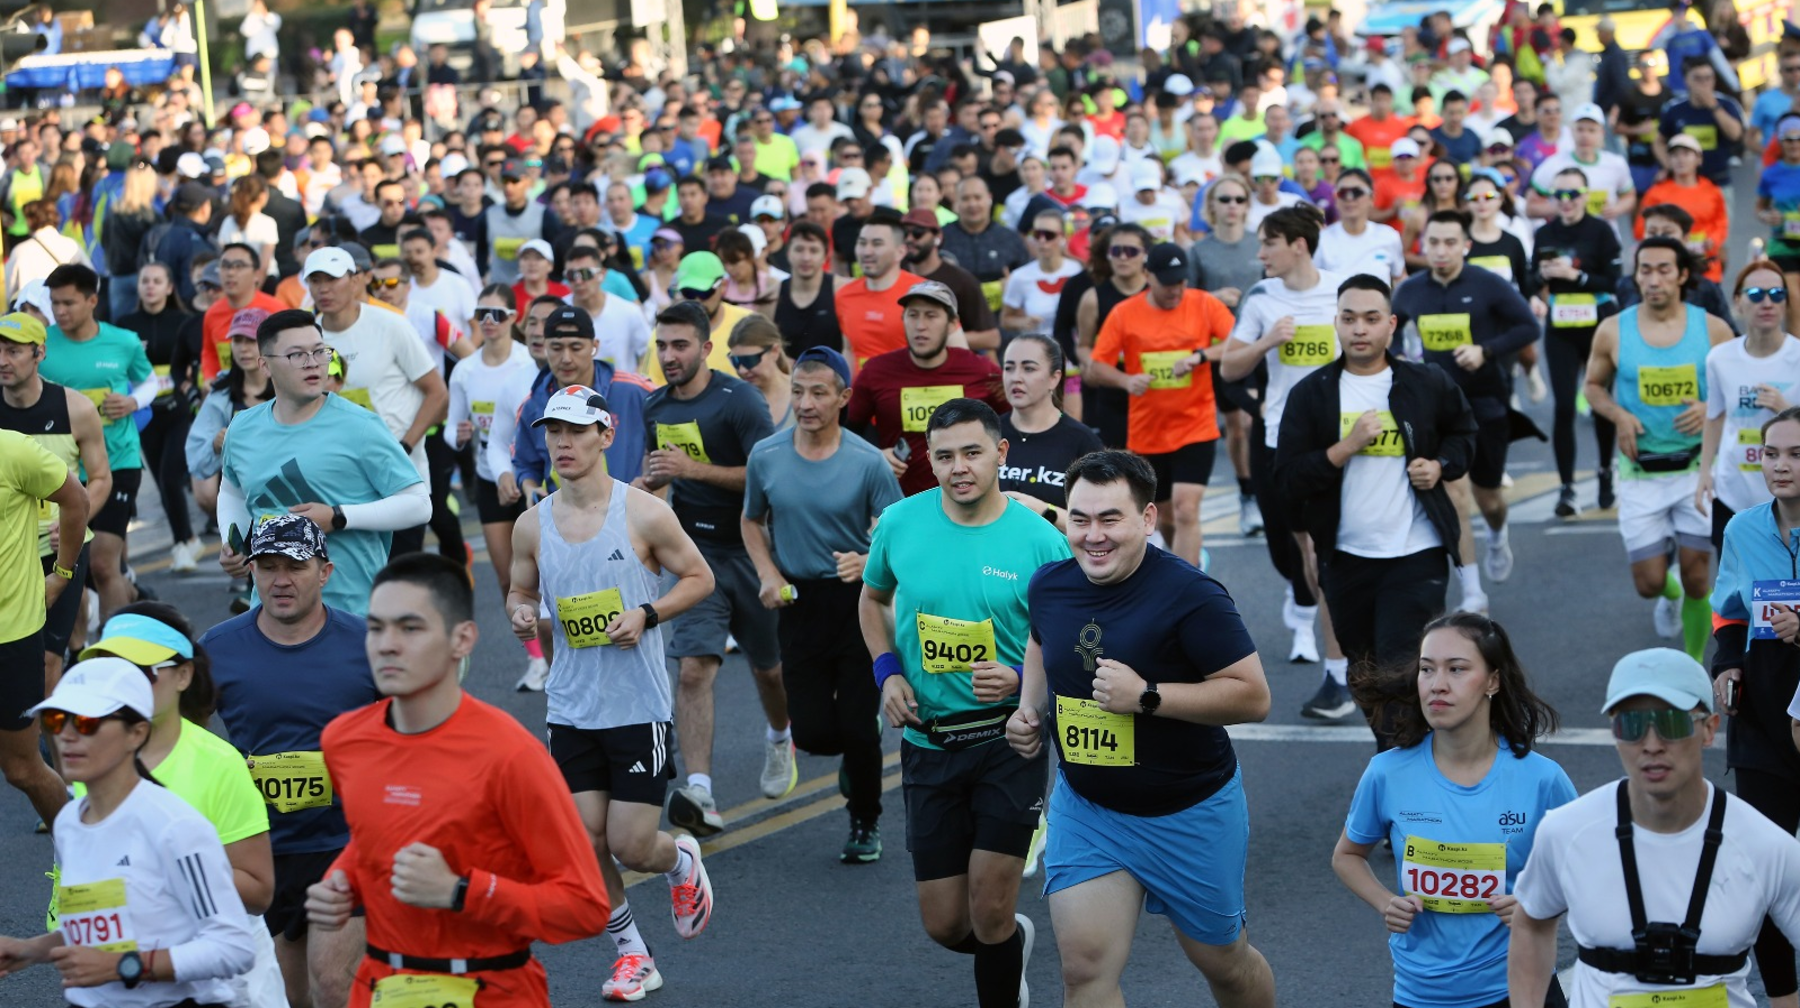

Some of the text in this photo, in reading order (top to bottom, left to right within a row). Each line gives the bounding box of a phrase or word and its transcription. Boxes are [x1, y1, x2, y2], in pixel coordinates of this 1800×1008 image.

[1428, 329, 1465, 342] 7268
[1285, 341, 1329, 356] 8786
[1150, 367, 1174, 380] 612
[1643, 381, 1694, 397] 10672
[998, 465, 1066, 487] ter.kz
[993, 568, 1018, 580] Halyk
[1754, 587, 1761, 597] K
[919, 620, 926, 631] C
[924, 639, 988, 663] 9402
[1058, 704, 1063, 714] B
[957, 727, 1001, 741] DEMIX
[1066, 725, 1118, 752] 8114
[255, 776, 325, 799] 10175
[1406, 845, 1415, 857] B
[1407, 868, 1498, 899] 10282
[63, 913, 123, 945] 10791
